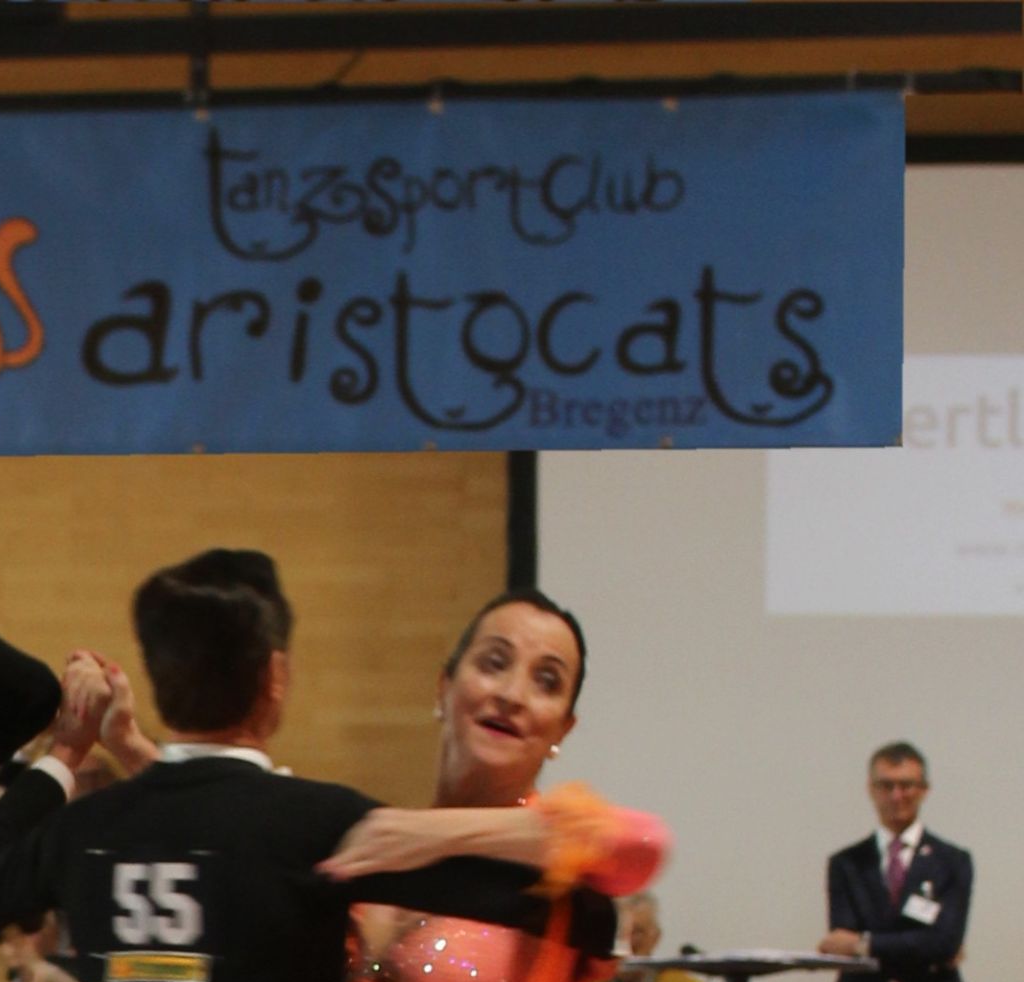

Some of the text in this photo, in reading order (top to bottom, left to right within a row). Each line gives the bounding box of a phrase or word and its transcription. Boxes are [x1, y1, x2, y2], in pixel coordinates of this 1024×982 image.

[81, 265, 834, 432] aristocats
[528, 388, 707, 438] Bregenz
[112, 862, 204, 945] 55
